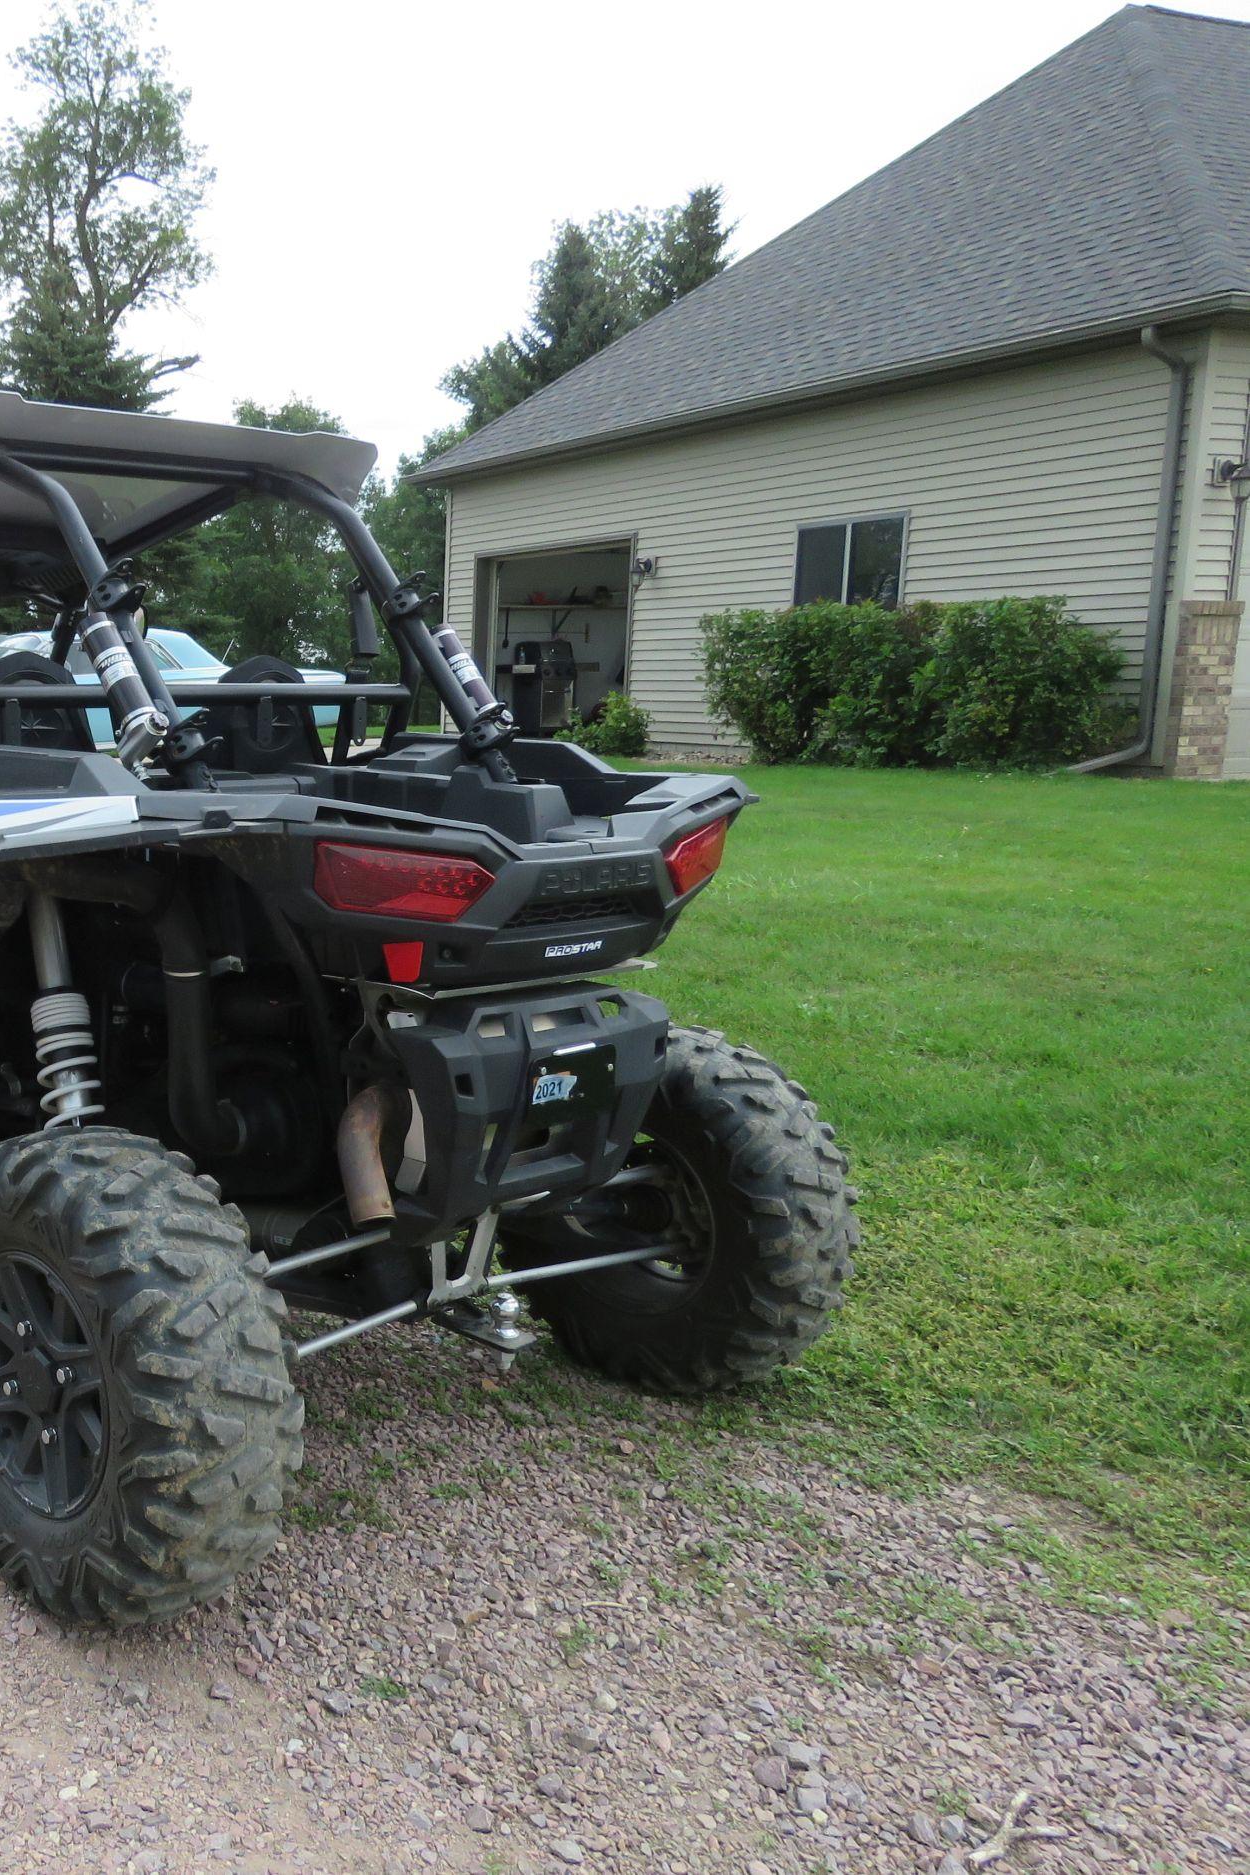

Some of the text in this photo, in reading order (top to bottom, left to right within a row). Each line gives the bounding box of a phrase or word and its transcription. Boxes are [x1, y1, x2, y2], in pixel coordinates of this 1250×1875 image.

[540, 861, 652, 896] POLARIS
[544, 940, 603, 957] PROSTAR
[535, 1080, 563, 1100] 2021
